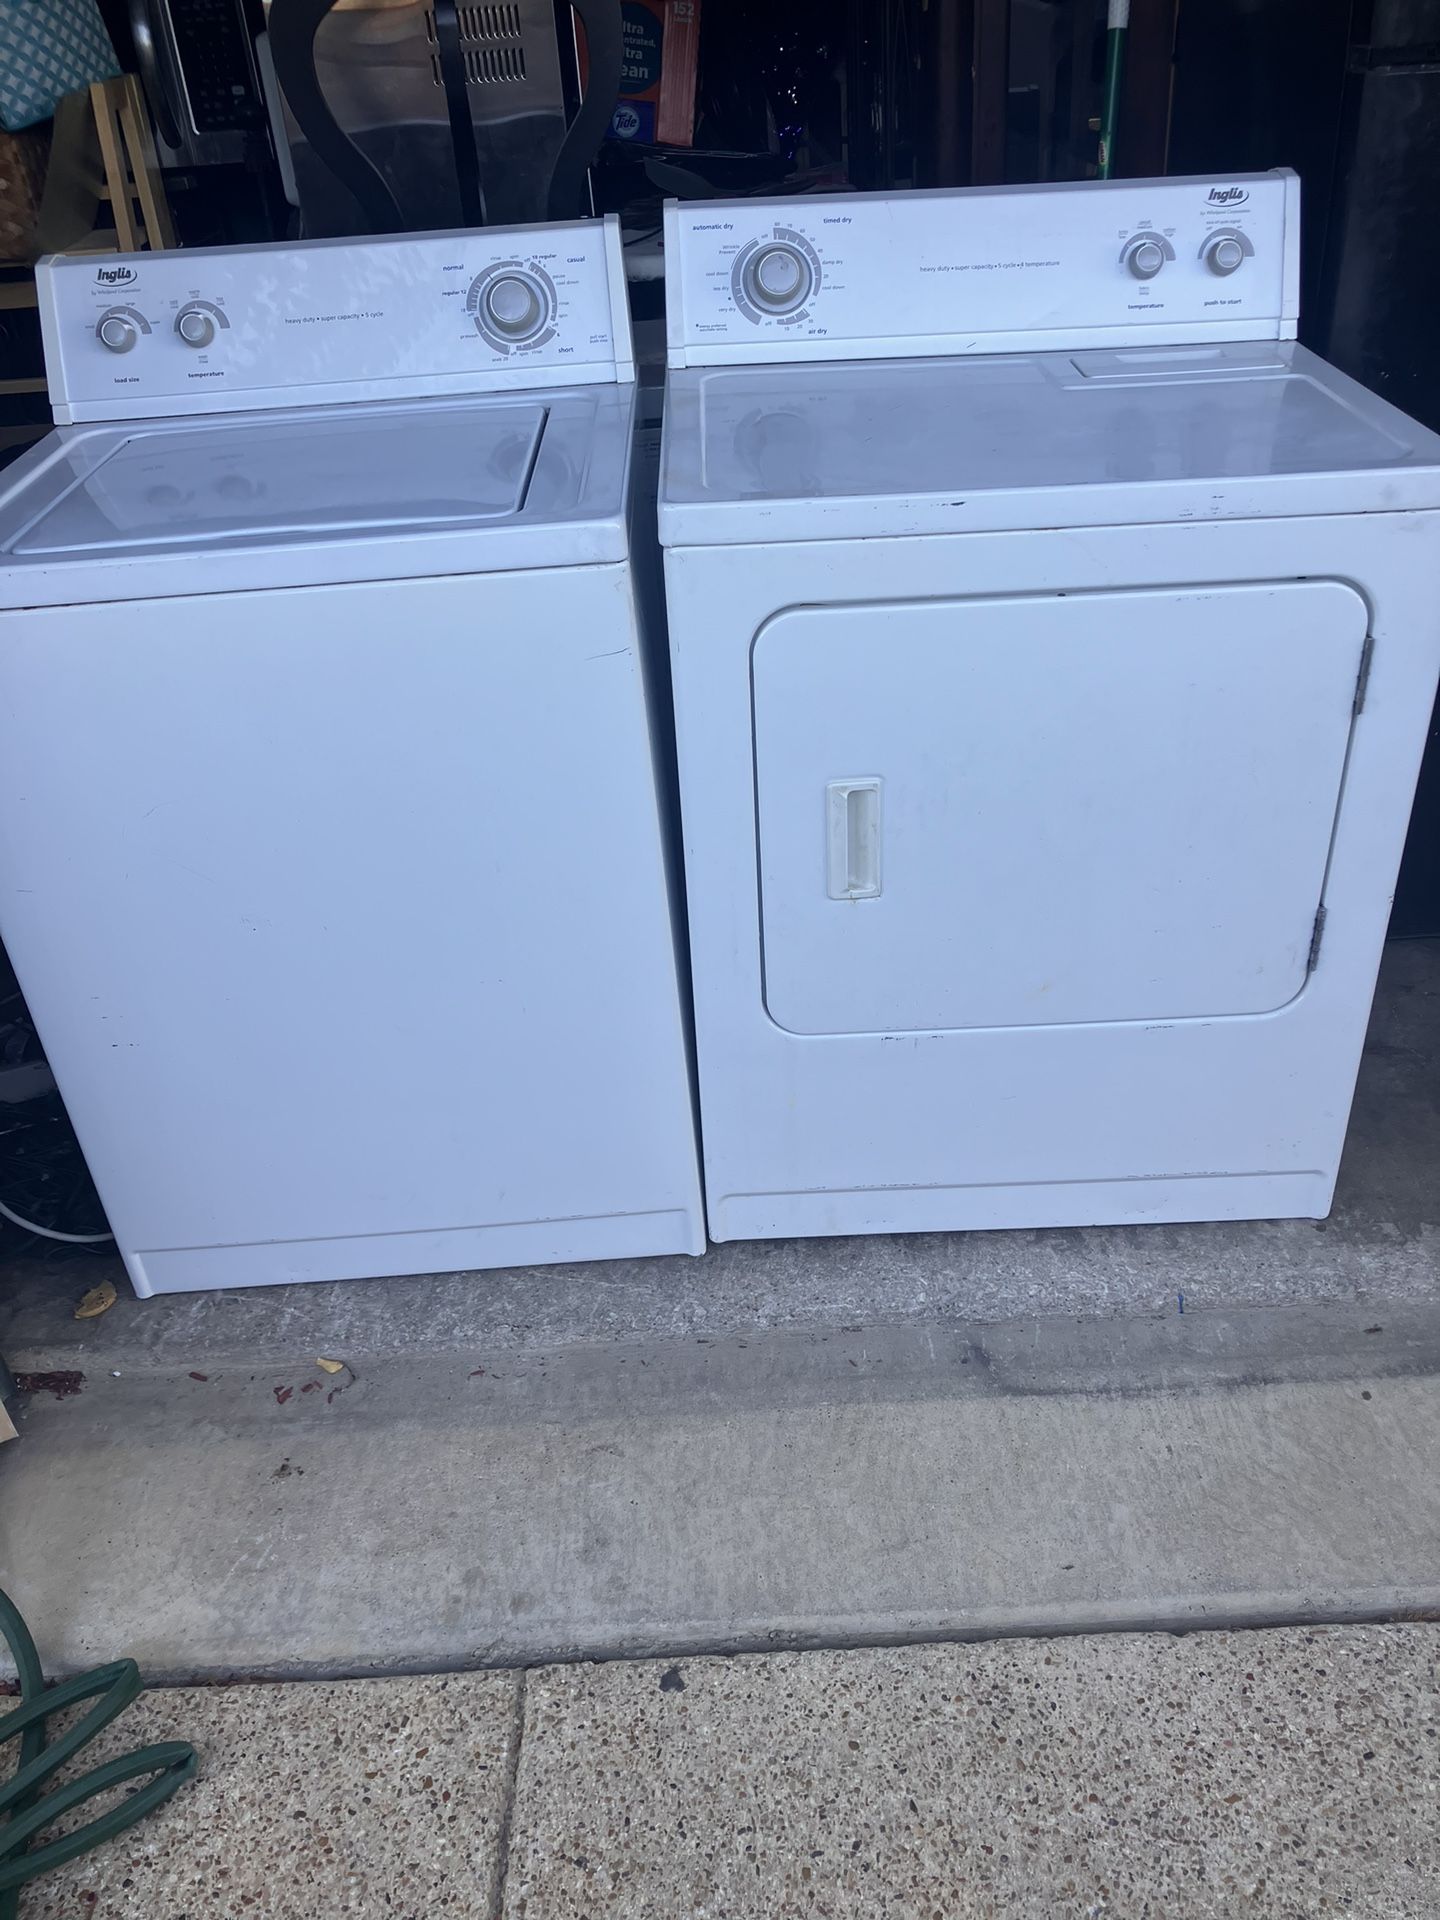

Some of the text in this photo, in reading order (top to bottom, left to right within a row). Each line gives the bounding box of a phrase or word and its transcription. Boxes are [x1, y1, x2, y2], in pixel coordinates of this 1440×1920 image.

[673, 1, 695, 16] 152
[622, 20, 644, 35] ltra
[616, 114, 637, 130] Tide
[1207, 187, 1243, 203] Inglis
[723, 223, 734, 231] dry
[937, 264, 950, 272] duty
[971, 263, 994, 271] capacity
[1024, 260, 1060, 268] temperature
[97, 267, 132, 283] Inglis
[817, 327, 828, 335] dry
[558, 346, 574, 354] short
